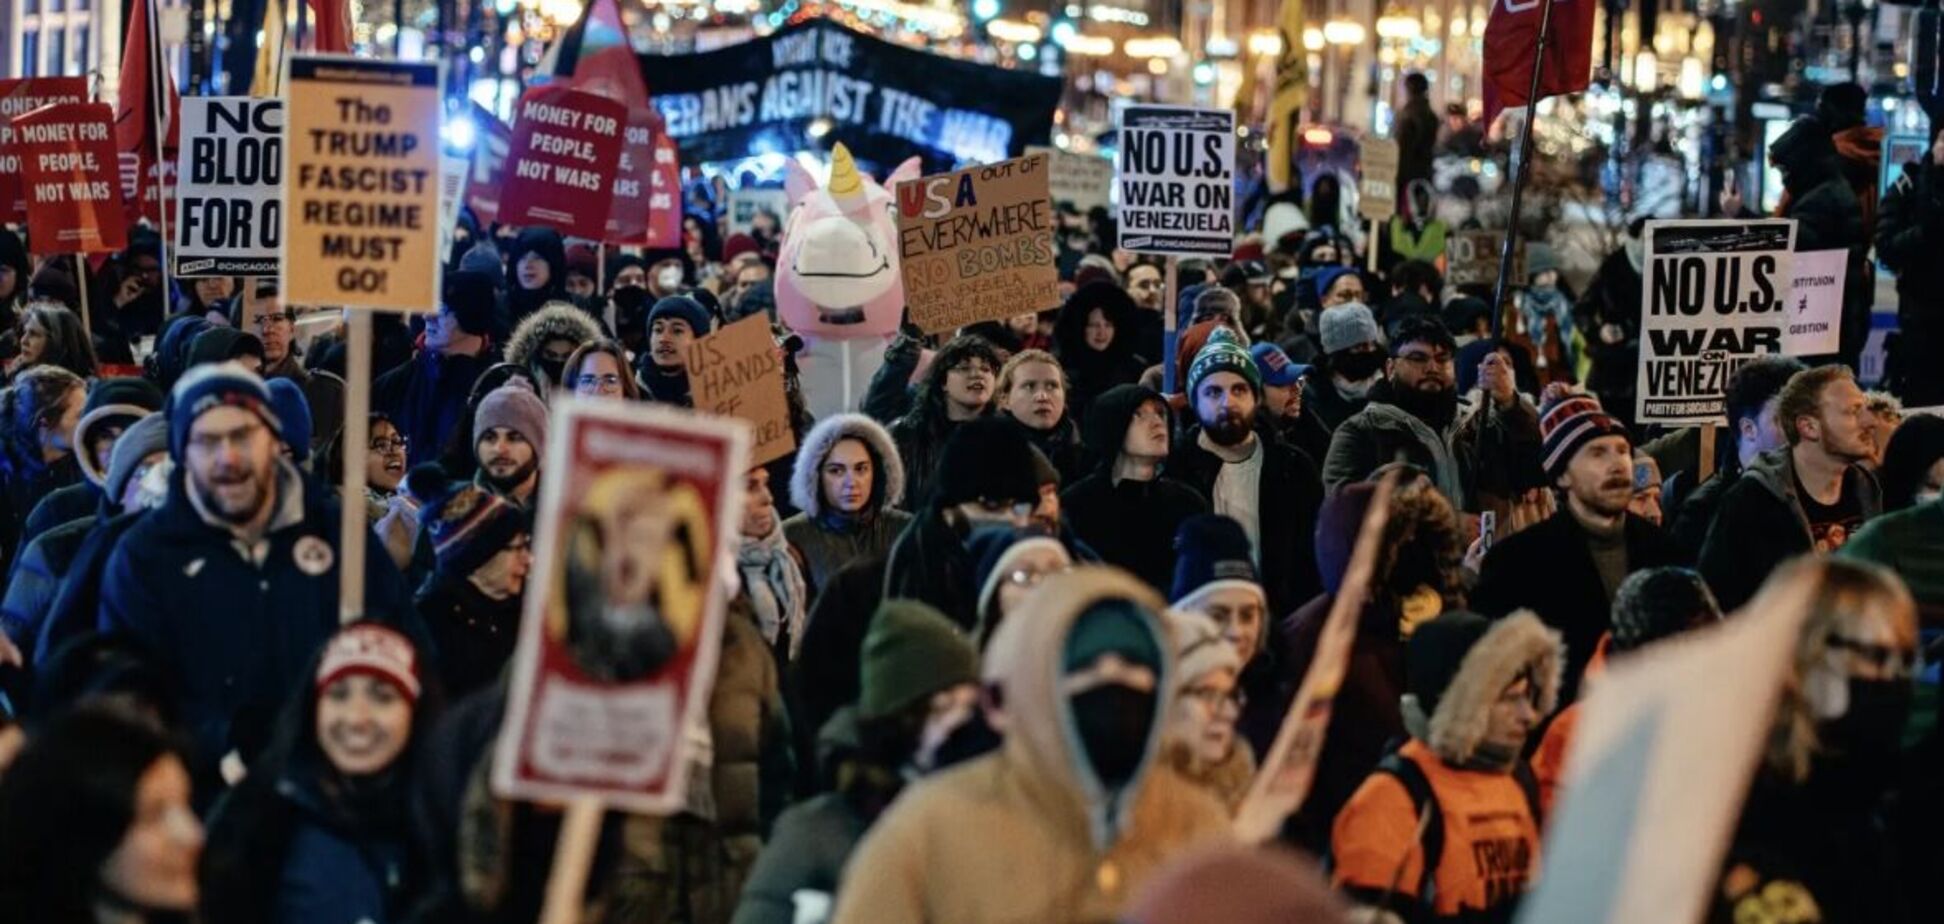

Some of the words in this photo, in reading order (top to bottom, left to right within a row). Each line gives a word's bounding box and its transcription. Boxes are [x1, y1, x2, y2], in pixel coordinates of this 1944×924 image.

[336, 97, 392, 125] The
[523, 101, 581, 128] MONEY
[583, 113, 617, 136] FOR
[761, 69, 873, 123] AGAINST
[880, 87, 938, 146] THE
[21, 123, 75, 143] MONEY
[79, 122, 108, 141] FOR
[308, 128, 418, 157] TRUMP
[530, 132, 597, 163] PEOPLE,
[39, 152, 100, 173] PEOPLE,
[1123, 130, 1166, 175] NO
[1173, 132, 1230, 179] U.S.
[298, 164, 428, 195] FASCIST
[516, 158, 551, 181] NOT
[555, 166, 601, 191] WARS
[900, 173, 977, 219] USA
[981, 162, 1015, 182] OUT
[1020, 157, 1041, 174] OF
[35, 183, 64, 203] NOT
[69, 182, 111, 201] WARS
[1123, 180, 1185, 208] WAR
[1194, 183, 1230, 210] ON
[181, 197, 253, 248] FOR
[303, 200, 421, 229] REGIME
[1123, 210, 1230, 233] VENEZUELA
[321, 234, 404, 261] MUST
[904, 258, 950, 291] NO
[957, 233, 1052, 279] BOMBS
[336, 267, 388, 294] GO!
[1650, 256, 1707, 316] NO
[1713, 255, 1783, 315] U.S.
[1647, 326, 1781, 357] WAR
[1701, 350, 1727, 361] ON
[704, 349, 776, 401] HANDS
[1188, 353, 1247, 386] IRISH
[1645, 402, 1670, 416] PARTY
